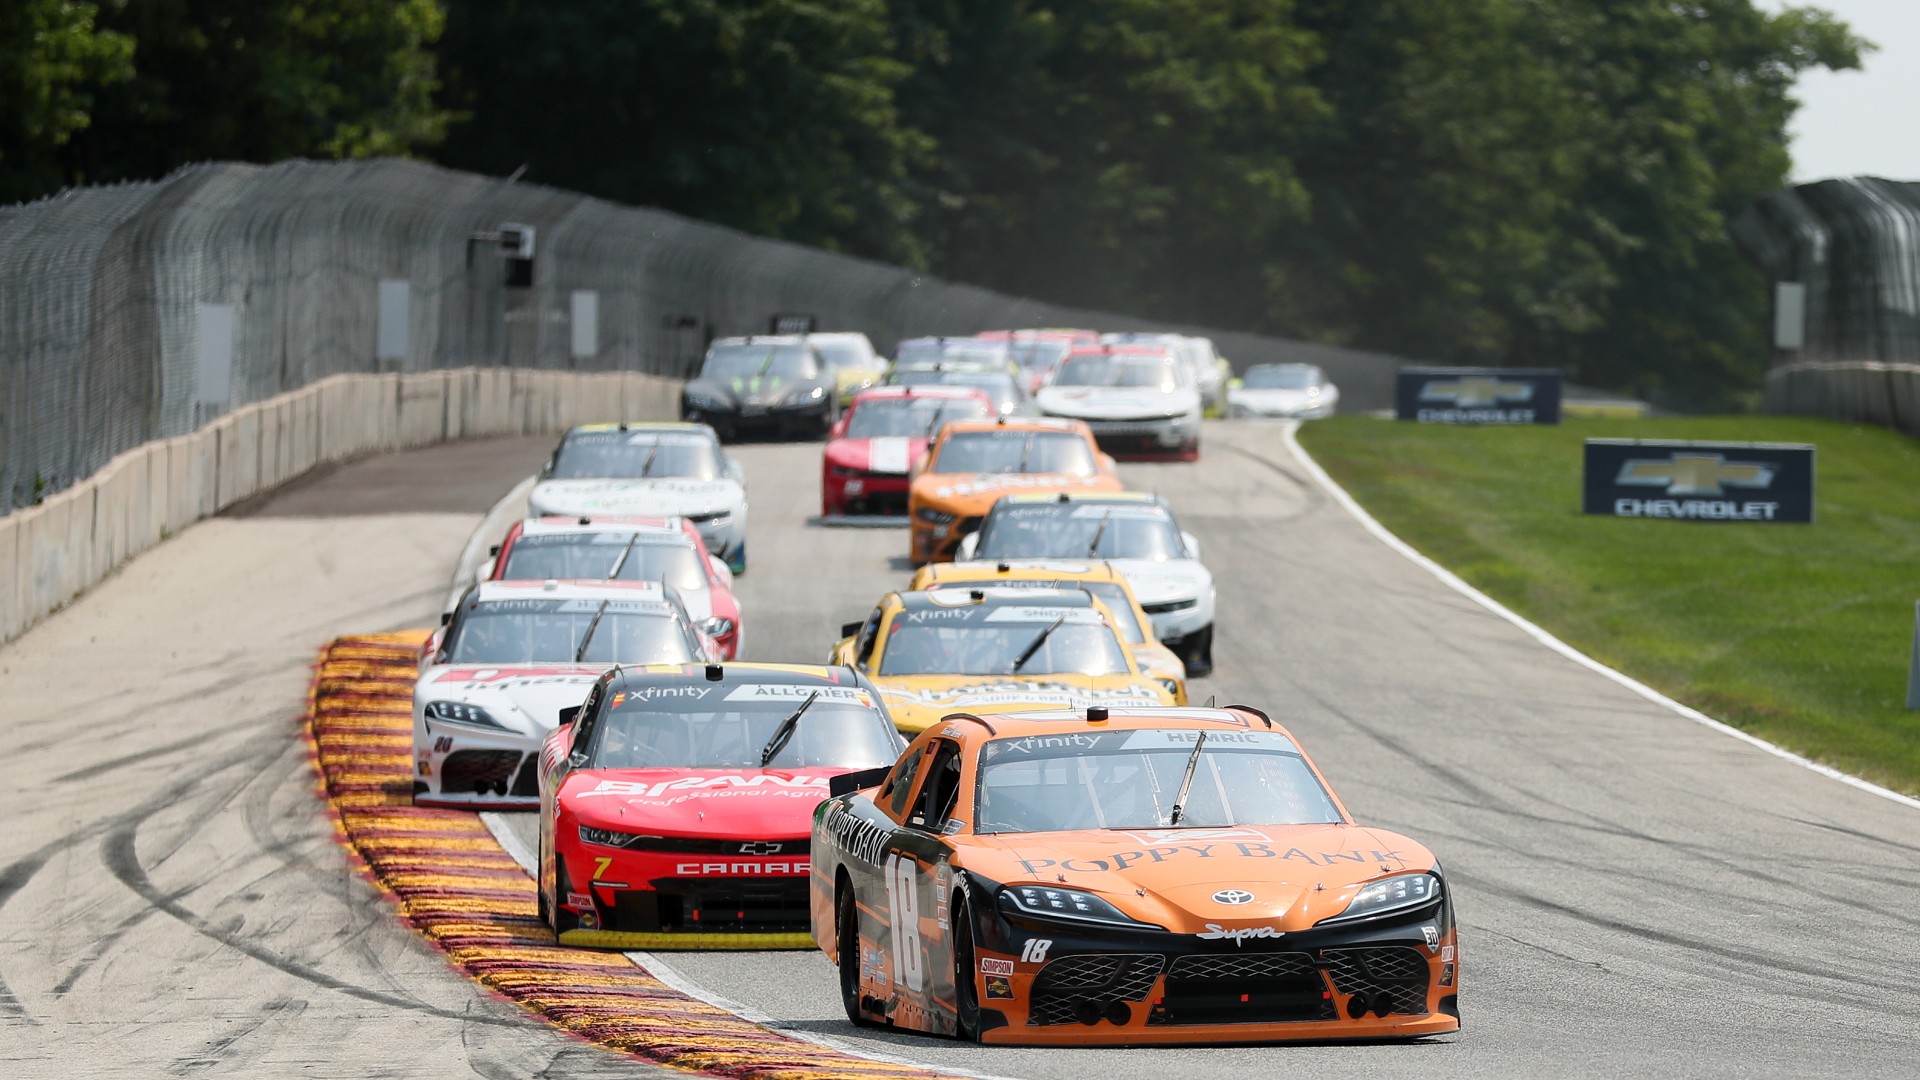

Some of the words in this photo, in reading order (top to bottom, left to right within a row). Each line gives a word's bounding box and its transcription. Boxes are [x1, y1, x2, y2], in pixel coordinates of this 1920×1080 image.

[1417, 408, 1535, 424] CHEVROLET
[1614, 498, 1779, 520] CHEVROLET
[907, 608, 974, 623] xfinity
[1023, 609, 1079, 618] SNIDER
[630, 685, 712, 702] xfinity
[1006, 734, 1102, 753] xfinity
[1166, 732, 1260, 743] HEMRIC
[627, 788, 768, 807] Professional
[826, 804, 863, 853] POPPY
[852, 818, 893, 869] BANK
[1014, 845, 1216, 874] POPPY
[1229, 843, 1410, 867] BANK
[593, 857, 613, 880] 7
[885, 851, 923, 992] 18
[1196, 923, 1286, 948] Supra
[1020, 938, 1053, 963] 18
[983, 959, 1012, 974] SIMPSON
